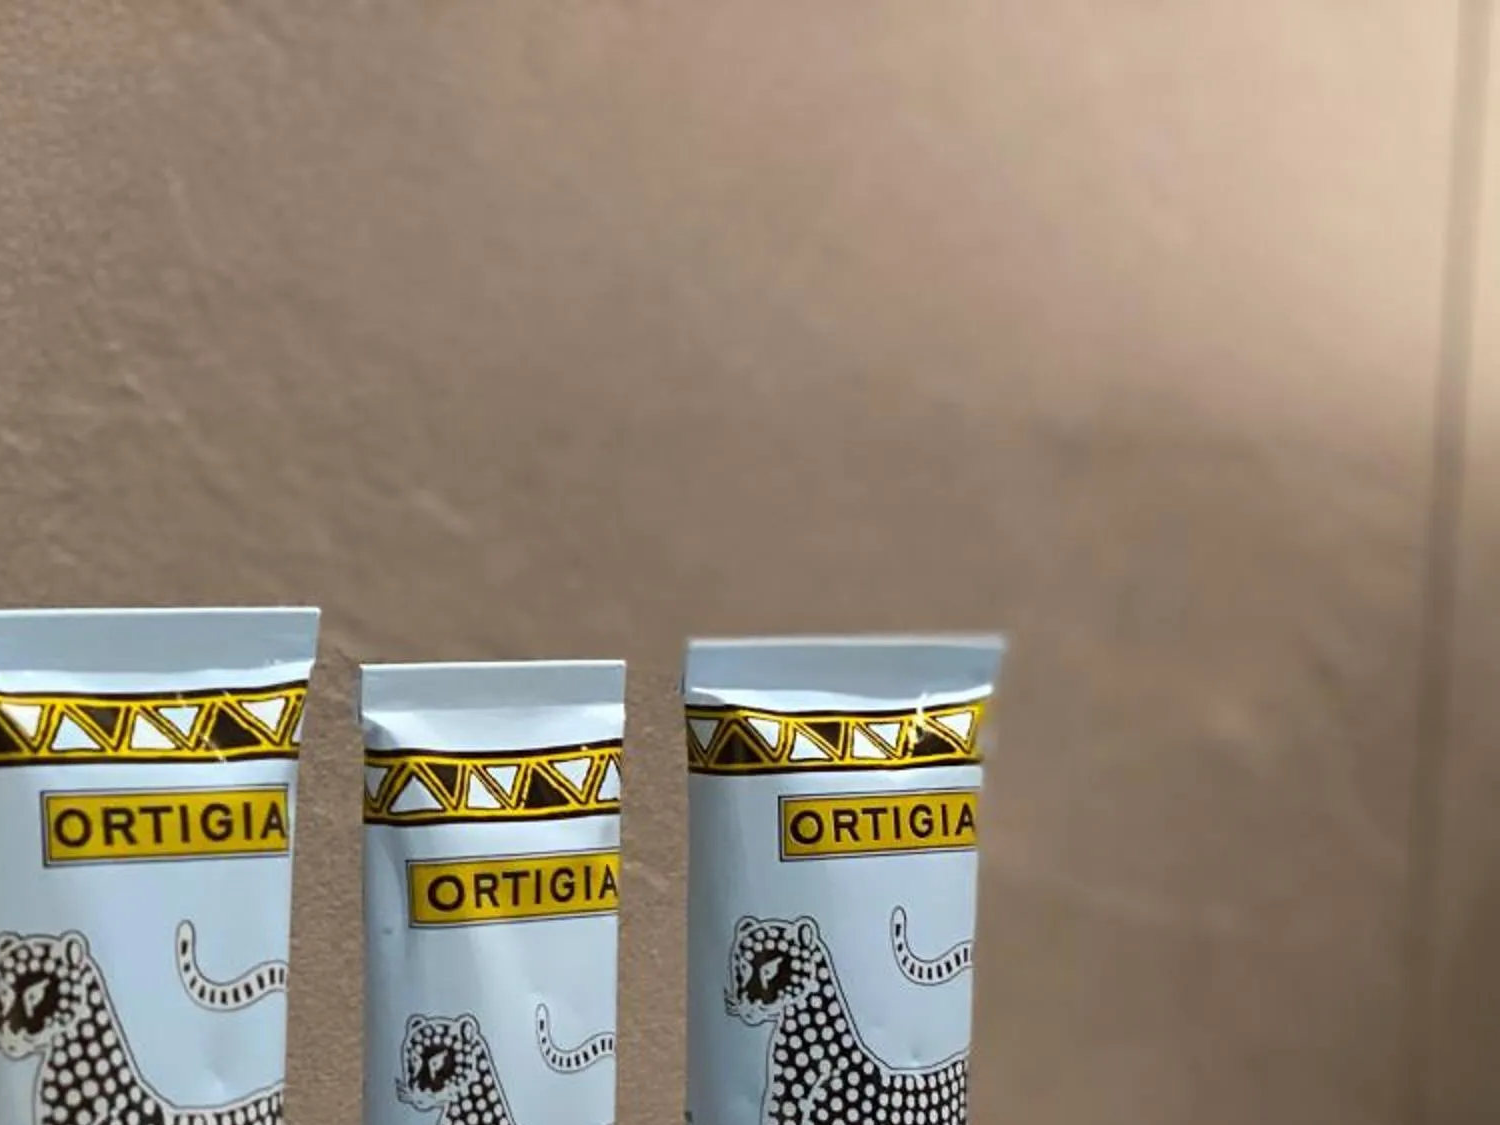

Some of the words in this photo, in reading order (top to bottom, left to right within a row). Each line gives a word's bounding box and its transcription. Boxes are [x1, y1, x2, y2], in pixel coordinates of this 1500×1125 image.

[54, 801, 287, 848] ORTIGIA
[789, 802, 976, 845] ORTIGIA
[427, 863, 618, 913] ORTIGIA
